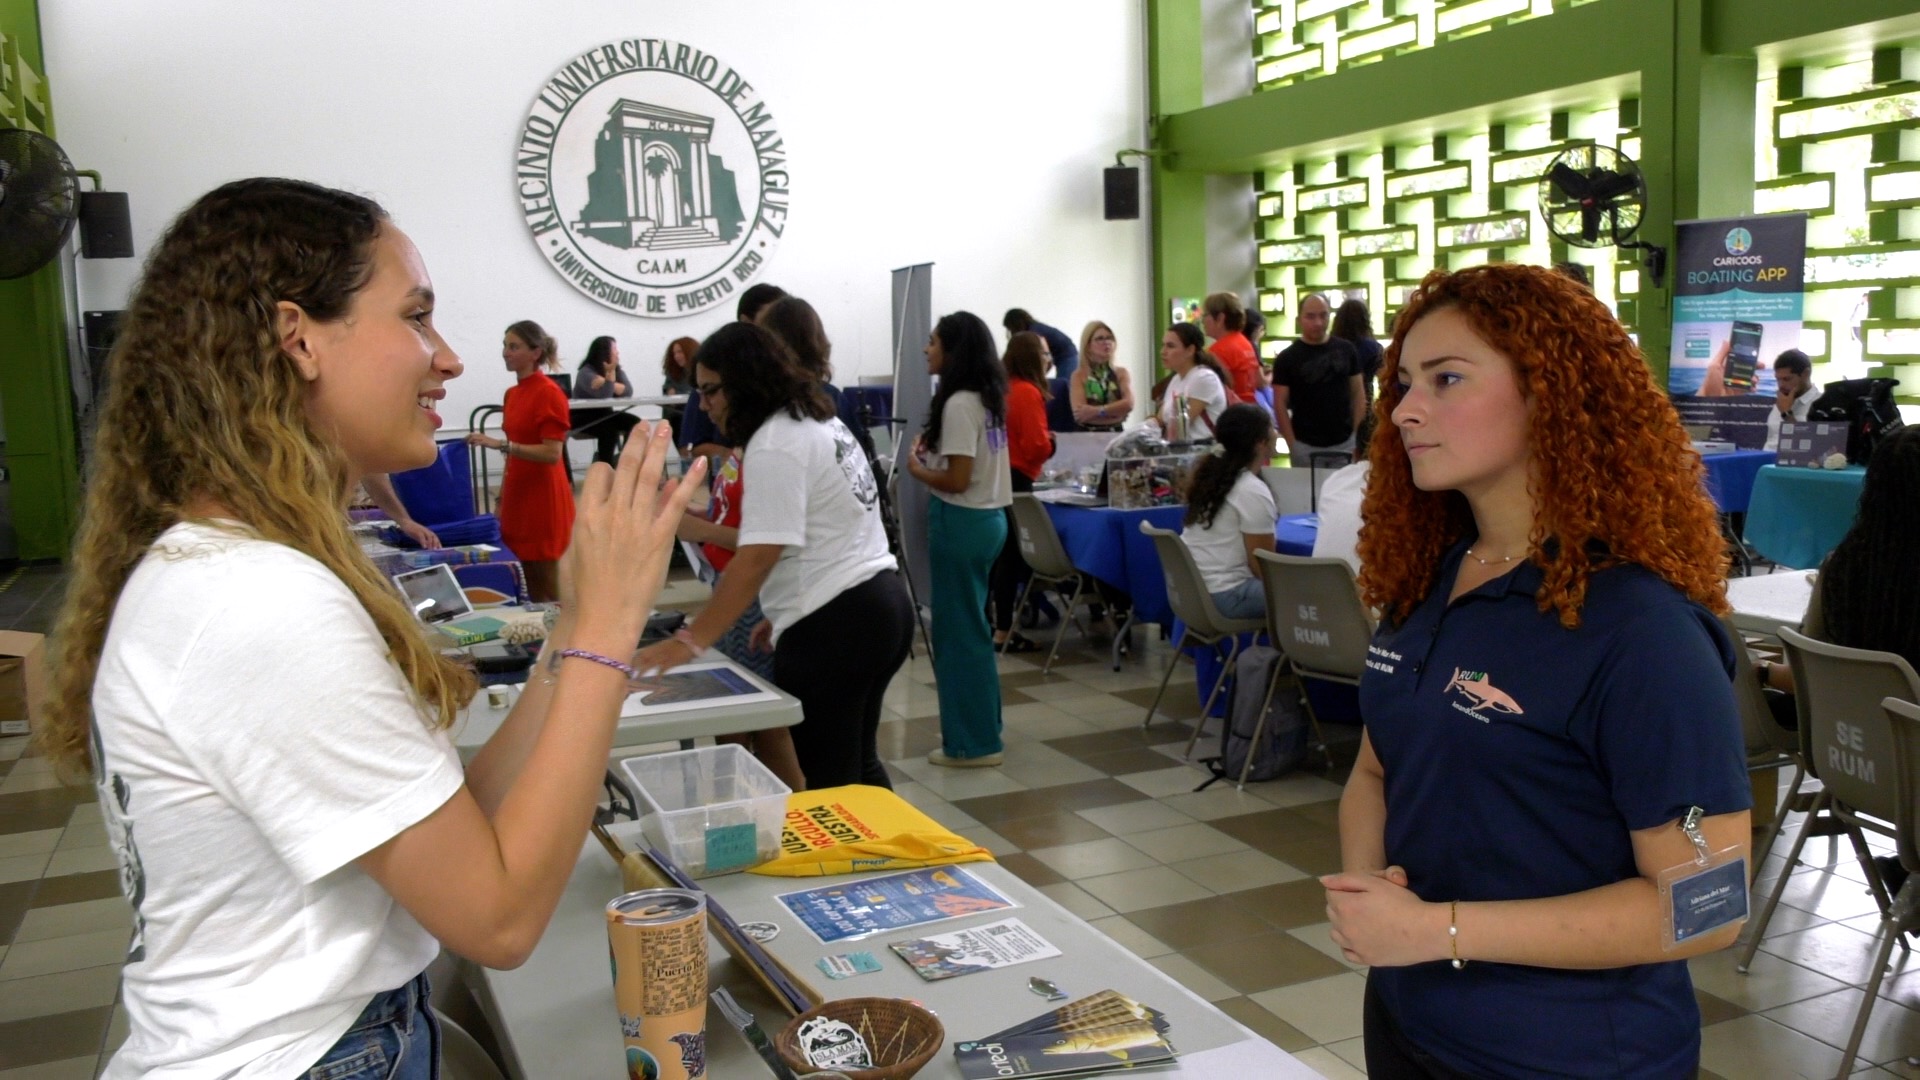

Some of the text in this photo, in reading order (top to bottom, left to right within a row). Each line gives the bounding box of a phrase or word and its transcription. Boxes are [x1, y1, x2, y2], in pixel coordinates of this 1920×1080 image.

[518, 39, 790, 239] RECINTO UNIVERSITARIO DE MAYAGUEZ
[637, 258, 687, 275] CAAM
[1713, 255, 1762, 267] CARICOOS
[553, 247, 764, 313] UNIVERSIDAD DE PUERTO RICO
[1688, 267, 1788, 284] BOATING APP
[1298, 605, 1318, 621] SE
[1294, 627, 1330, 646] RUM
[1458, 670, 1485, 681] RUM
[1836, 720, 1864, 752] SE
[1828, 746, 1876, 784] RUM
[785, 809, 835, 849] RGULLO.
[656, 965, 692, 977] Puerto
[814, 1042, 856, 1061] ISLA MAR
